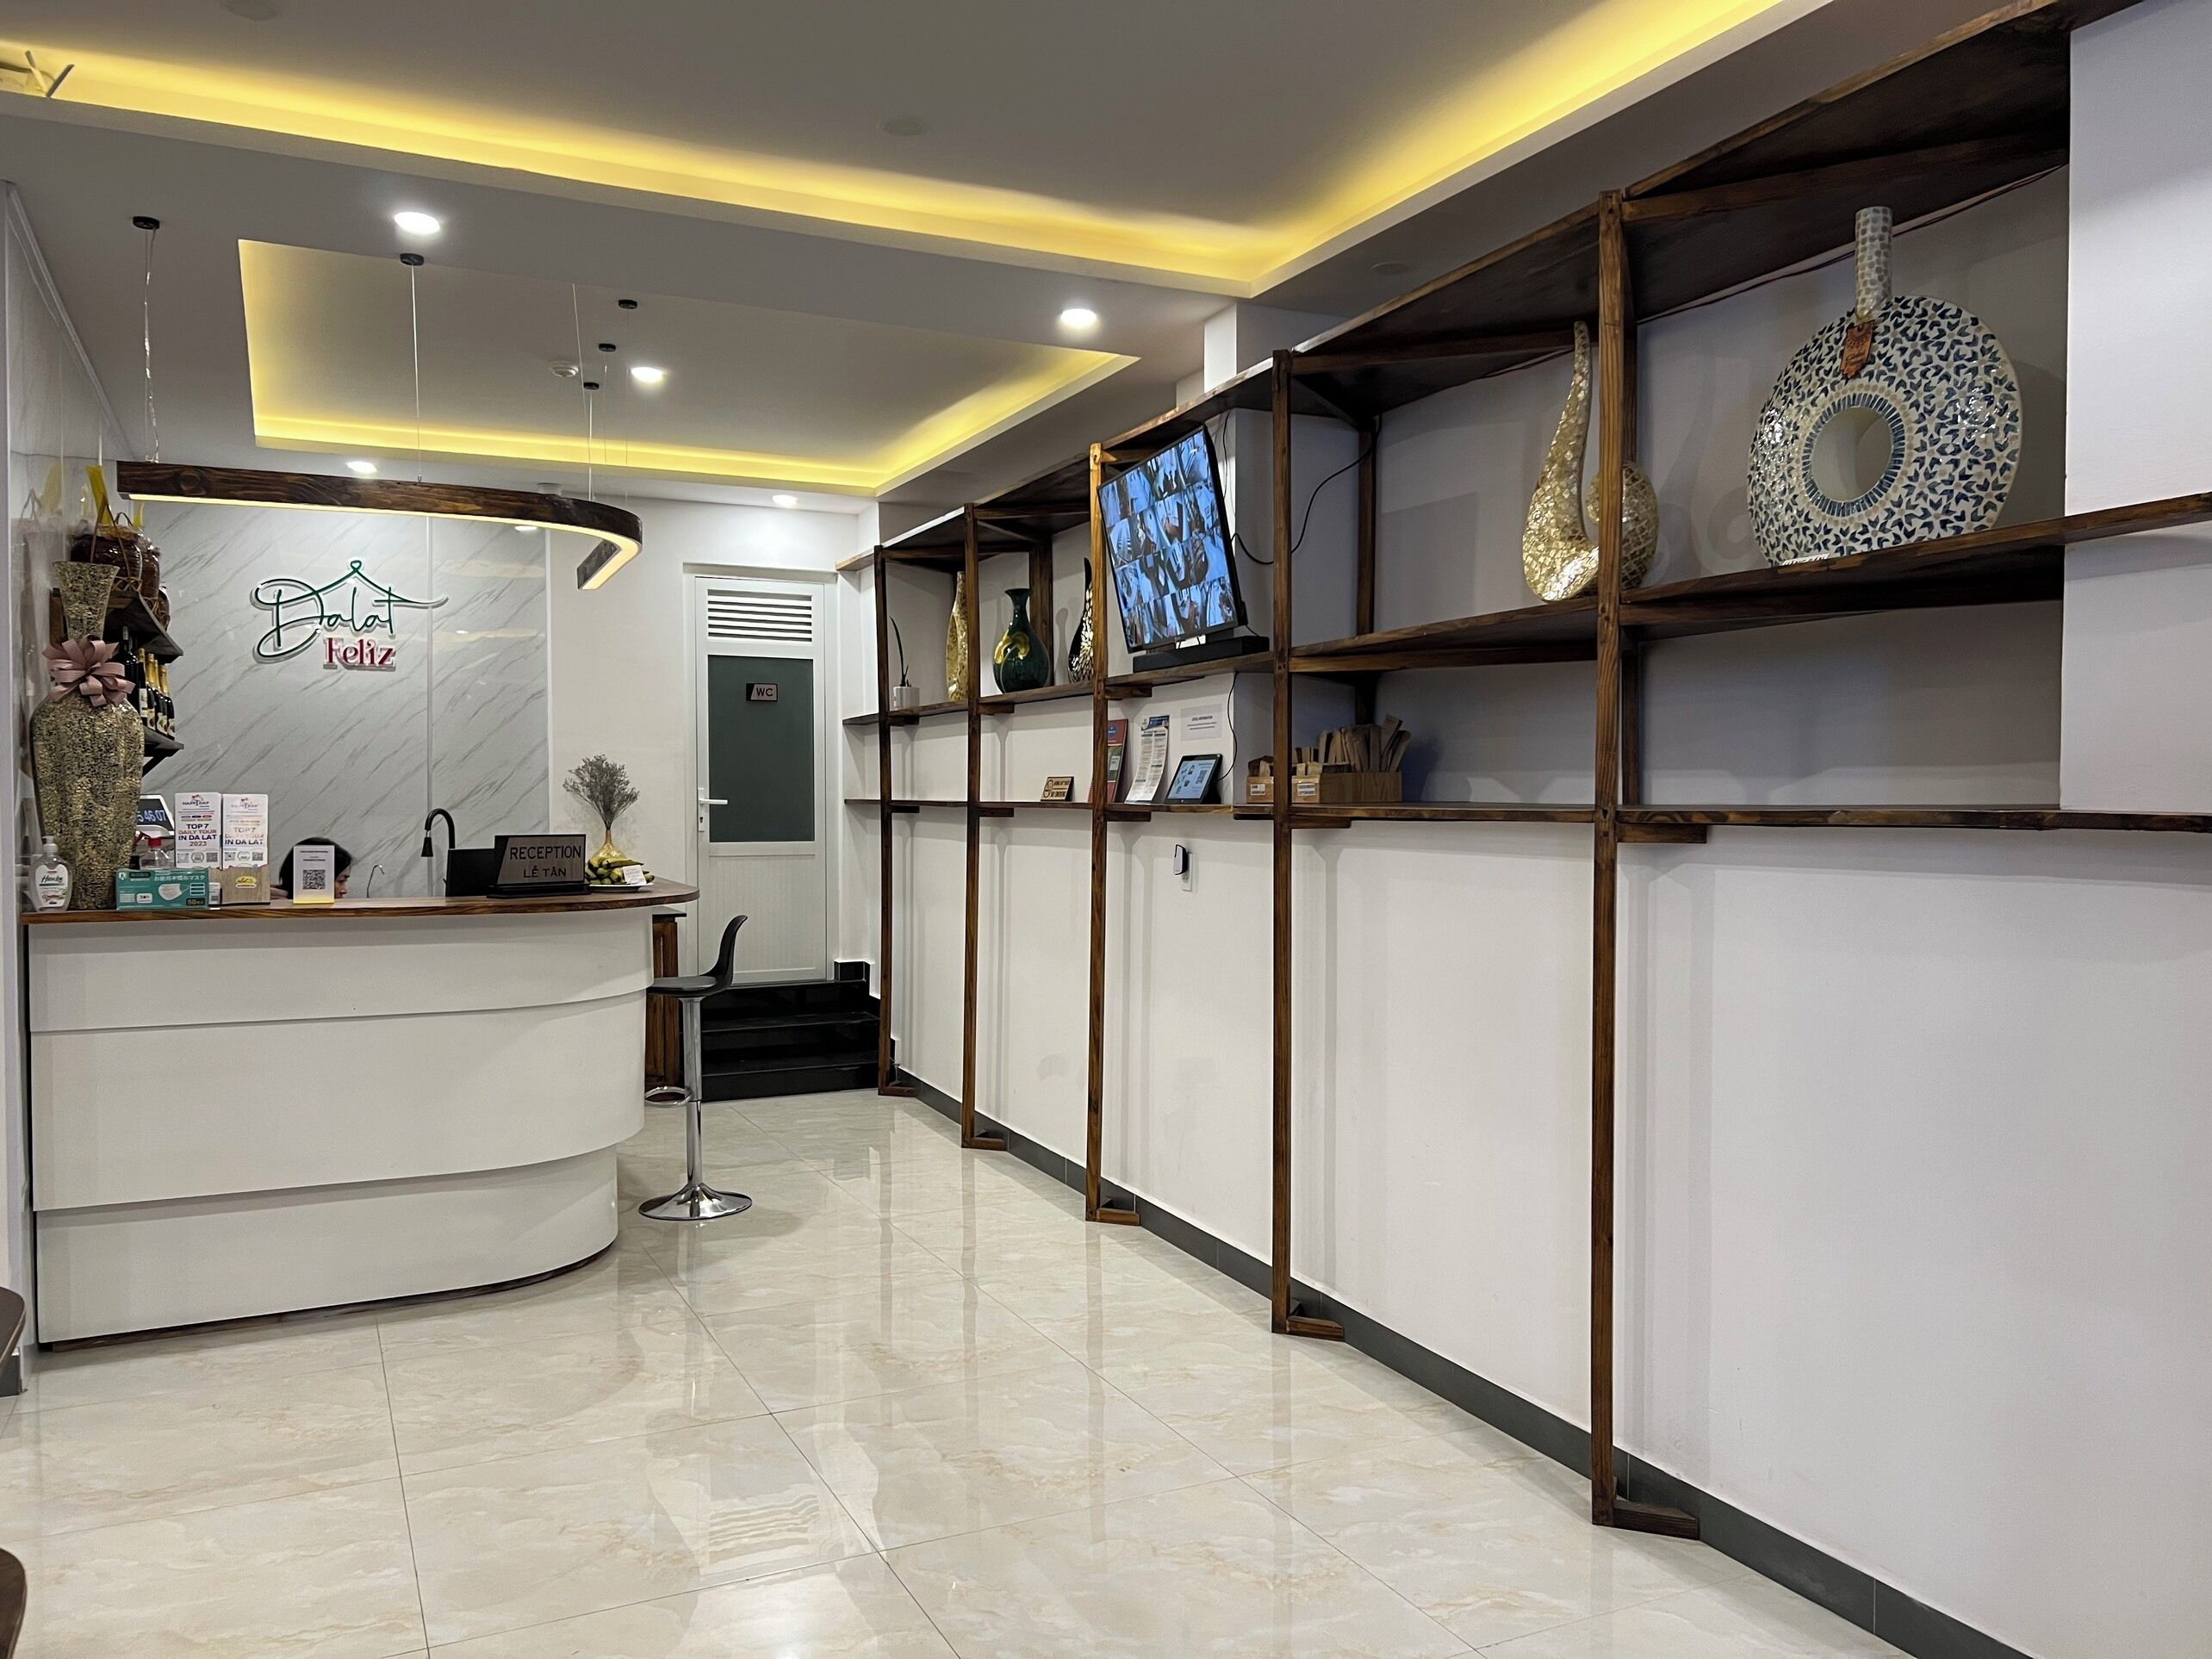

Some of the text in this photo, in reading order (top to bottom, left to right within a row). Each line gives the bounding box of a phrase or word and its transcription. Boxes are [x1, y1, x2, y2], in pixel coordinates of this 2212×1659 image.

[254, 560, 449, 658] Dalat
[325, 637, 395, 666] Feliz
[755, 687, 774, 697] WC
[510, 845, 581, 860] RECEPTION
[543, 867, 567, 877] TÂN
